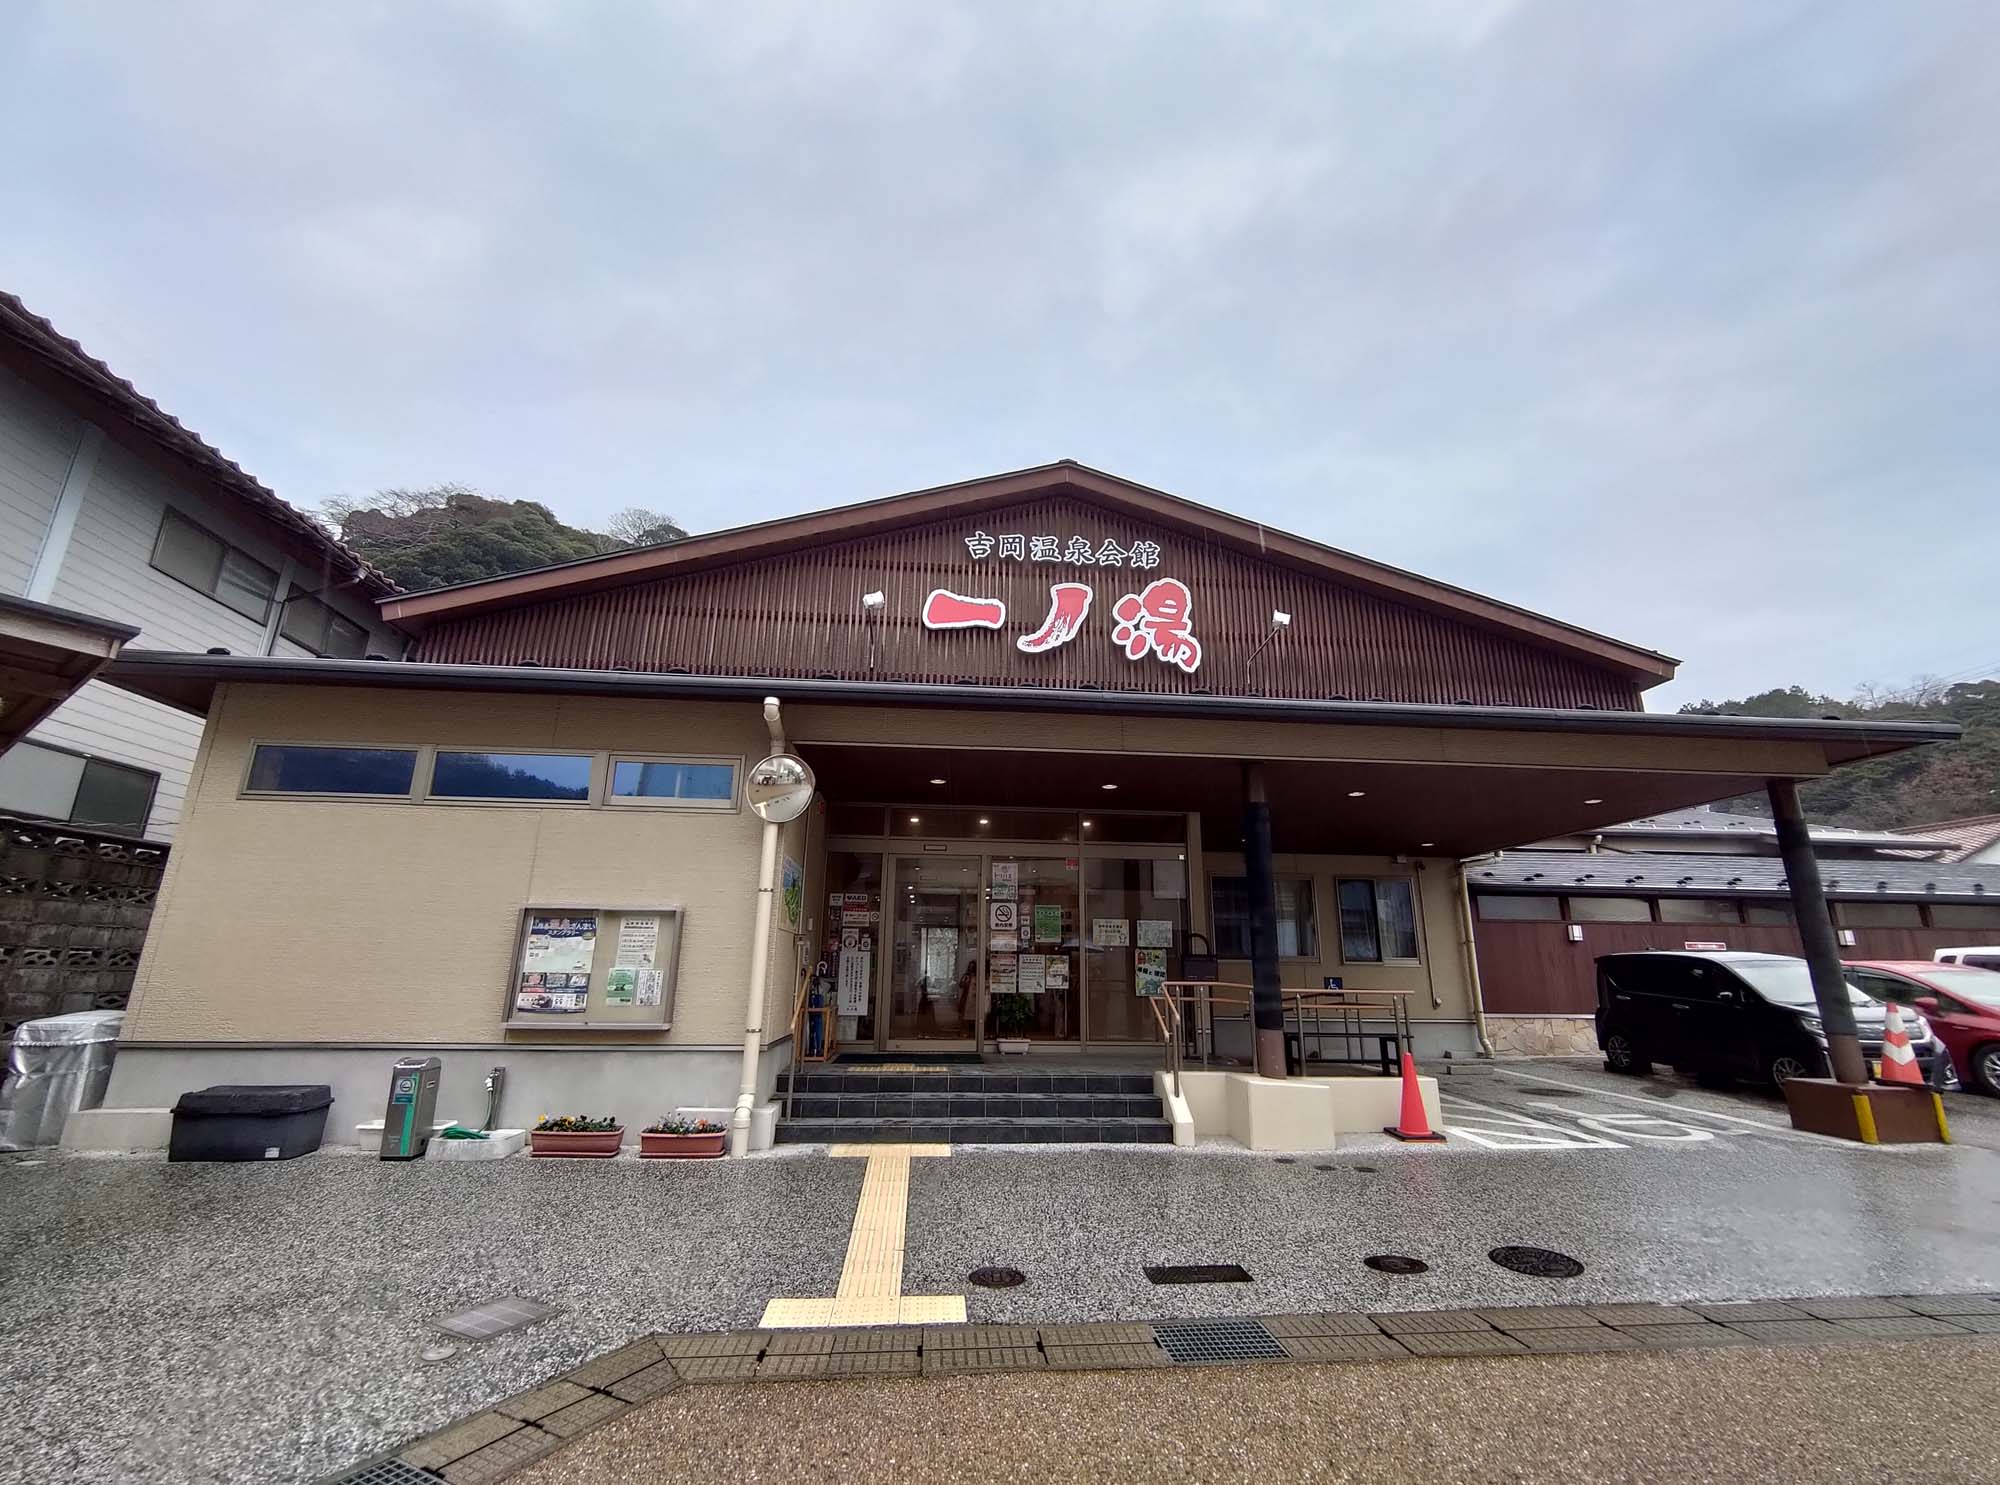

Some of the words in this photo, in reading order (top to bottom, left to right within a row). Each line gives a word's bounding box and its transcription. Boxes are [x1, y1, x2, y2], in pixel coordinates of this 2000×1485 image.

[965, 531, 1160, 569] 吉岡温泉会館
[922, 577, 1202, 673] 一ノ湯
